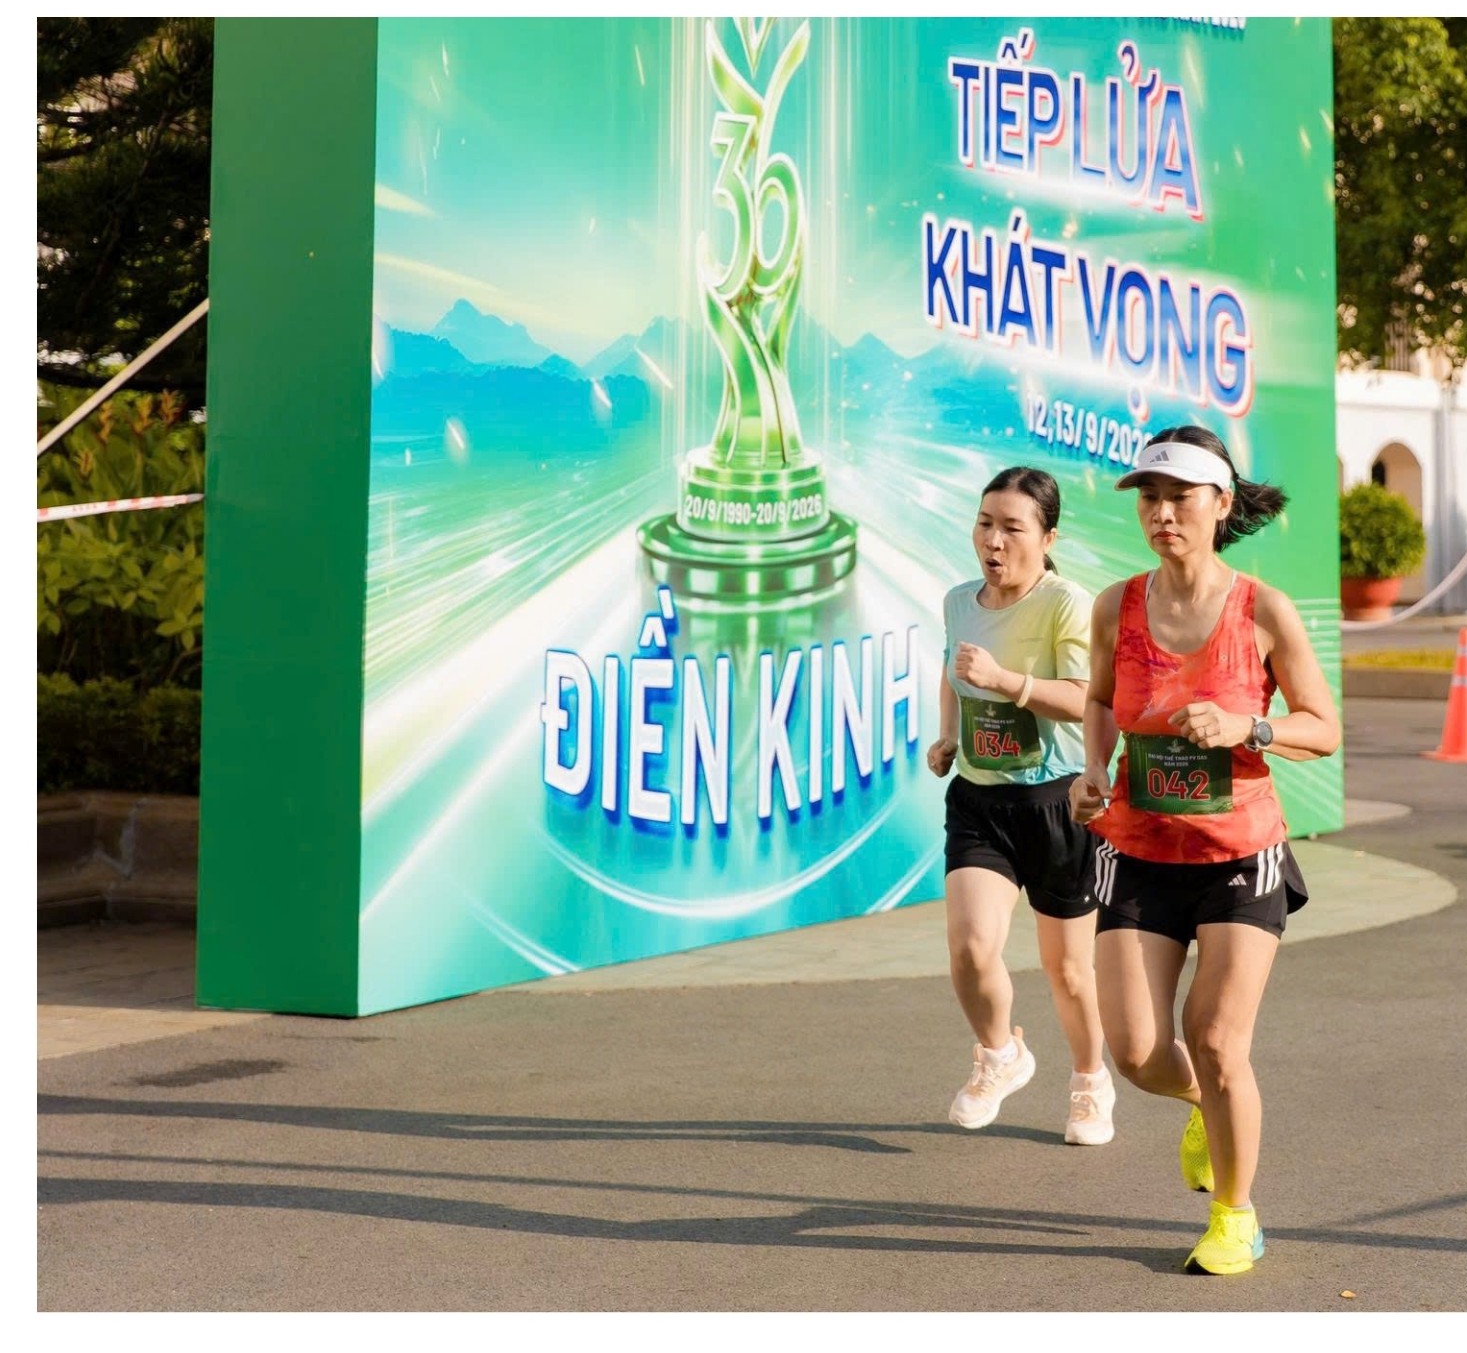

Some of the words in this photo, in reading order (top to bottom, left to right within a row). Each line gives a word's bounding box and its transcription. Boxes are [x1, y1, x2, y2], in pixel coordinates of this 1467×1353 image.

[950, 29, 1062, 173] TIẾP
[1070, 42, 1203, 215] LỬA
[924, 212, 1070, 356] KHÁT
[1075, 254, 1252, 416] VỌNG
[1026, 394, 1153, 469] 12,13/9/202
[540, 586, 730, 824] ĐIỀN
[757, 625, 920, 820] KINH
[974, 730, 1021, 759] 034
[1147, 768, 1211, 800] 042
